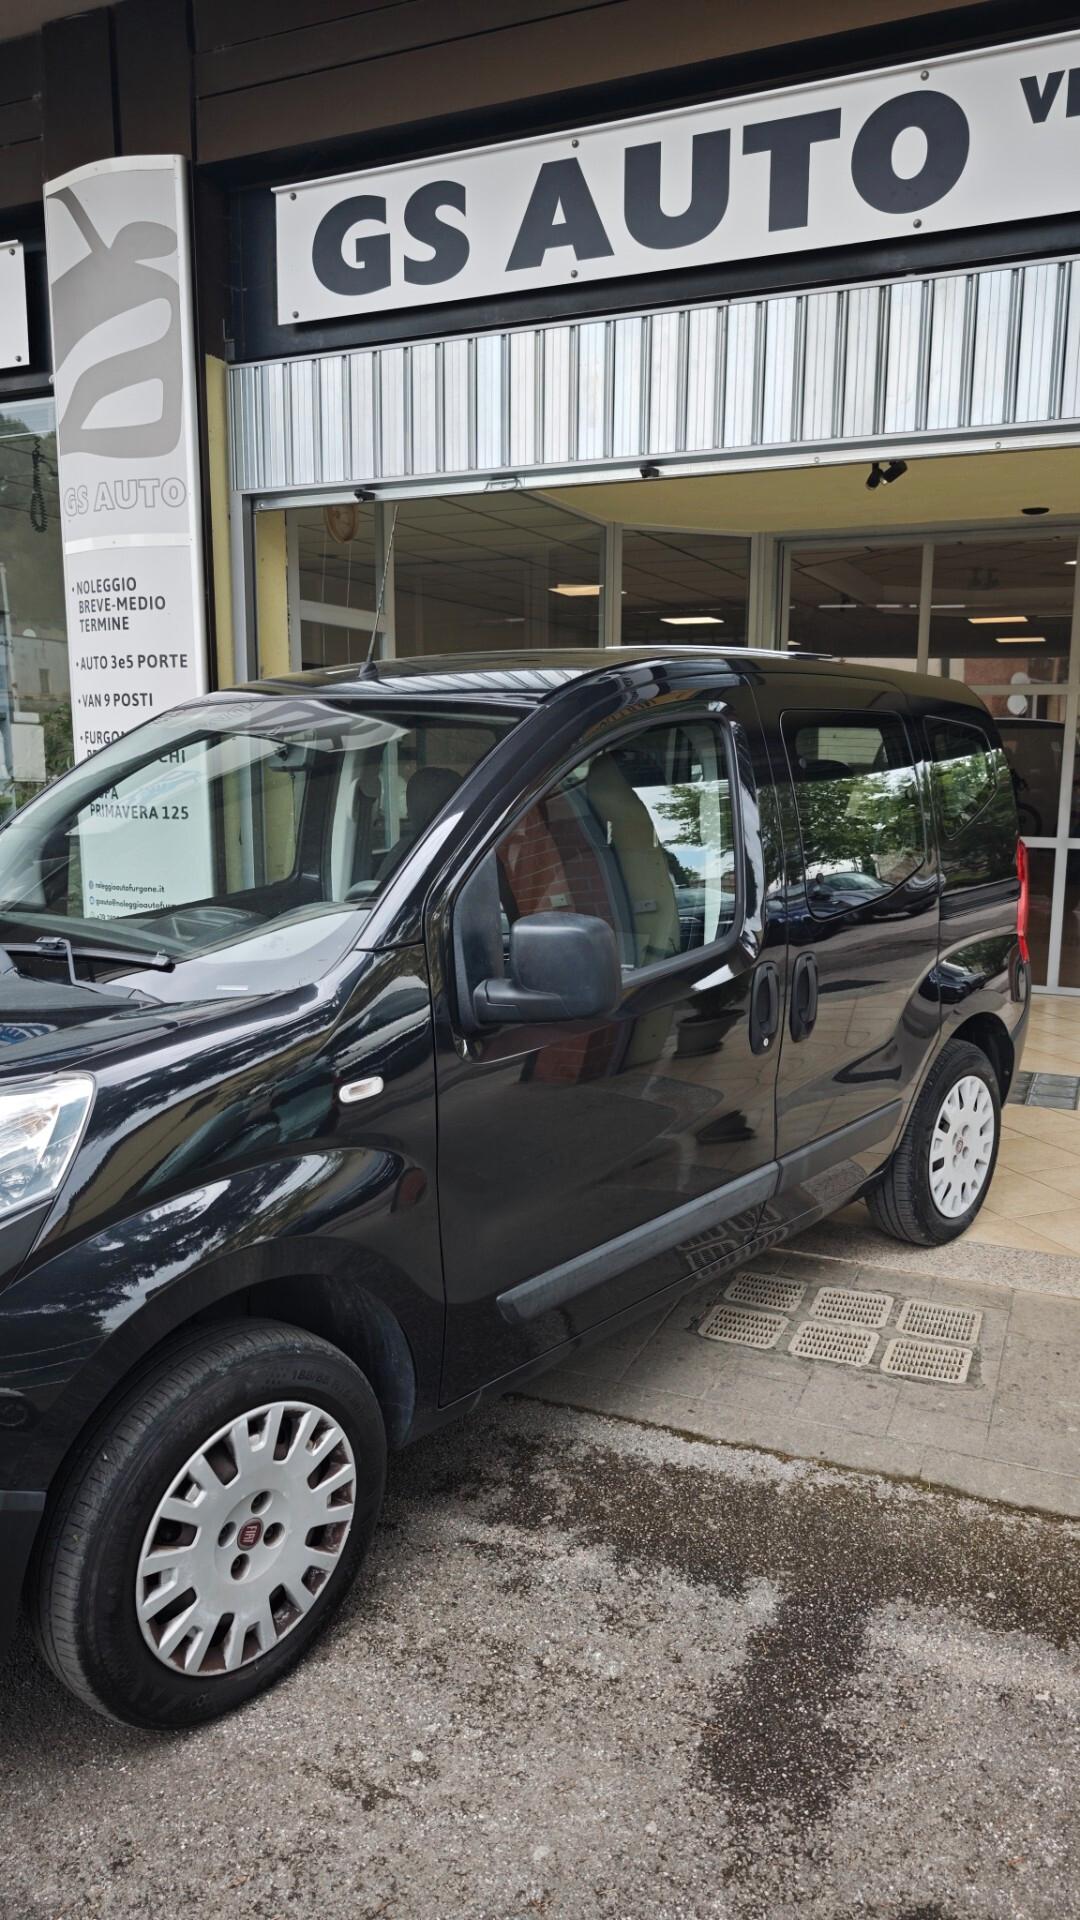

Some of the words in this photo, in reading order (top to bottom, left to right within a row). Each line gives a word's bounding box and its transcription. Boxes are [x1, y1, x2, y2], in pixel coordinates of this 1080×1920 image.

[312, 180, 470, 296] GS
[504, 90, 970, 272] AUTO
[64, 484, 89, 517] GS
[93, 477, 187, 512] AUTO
[76, 577, 137, 595] NOLEGGIO
[79, 596, 166, 614] BREVE-MEDIO
[79, 616, 130, 633] TERMINE
[80, 655, 108, 671] AUTO
[111, 655, 134, 669] 3e5
[138, 654, 188, 668] PORTE
[82, 694, 102, 707] VAN
[104, 693, 111, 707] 9
[113, 693, 153, 707] POSTI
[90, 803, 158, 820] PRIMAVERA
[162, 805, 189, 820] 125
[242, 1525, 258, 1543] FIAT
